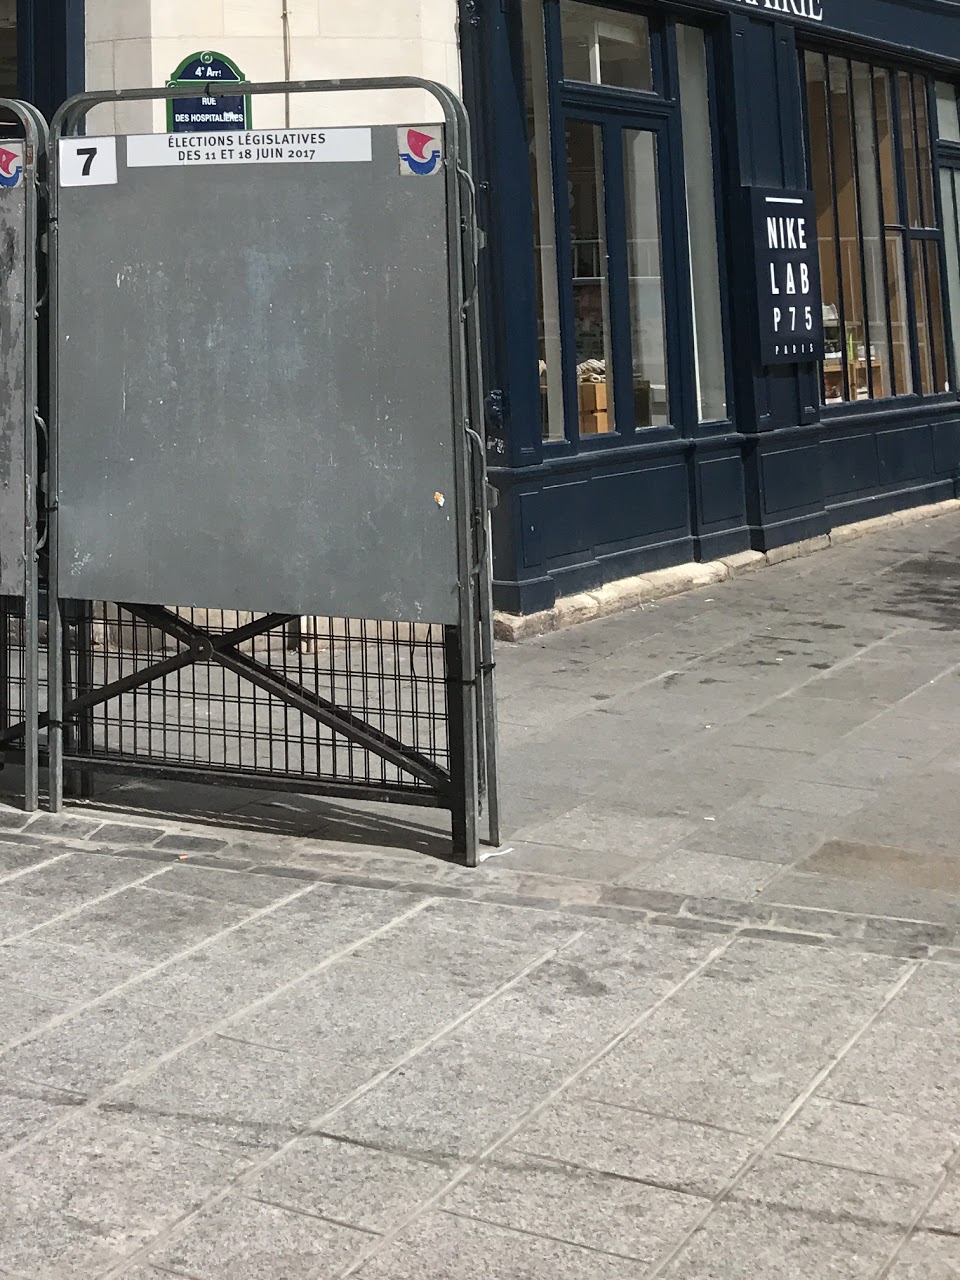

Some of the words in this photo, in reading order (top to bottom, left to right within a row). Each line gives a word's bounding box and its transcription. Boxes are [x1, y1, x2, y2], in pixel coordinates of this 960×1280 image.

[201, 97, 217, 106] RUE
[175, 113, 190, 122] DES
[168, 135, 234, 148] ÉLECTIONS
[238, 133, 326, 146] LÉGISLATIVES
[178, 150, 200, 161] DES
[205, 151, 217, 160] 11
[220, 149, 234, 160] ET
[238, 148, 252, 159] 18
[256, 147, 283, 161] JUIN
[287, 148, 316, 160] 2017
[76, 147, 98, 176] 7
[766, 216, 807, 249] NIKE
[775, 343, 814, 355] PARIS
